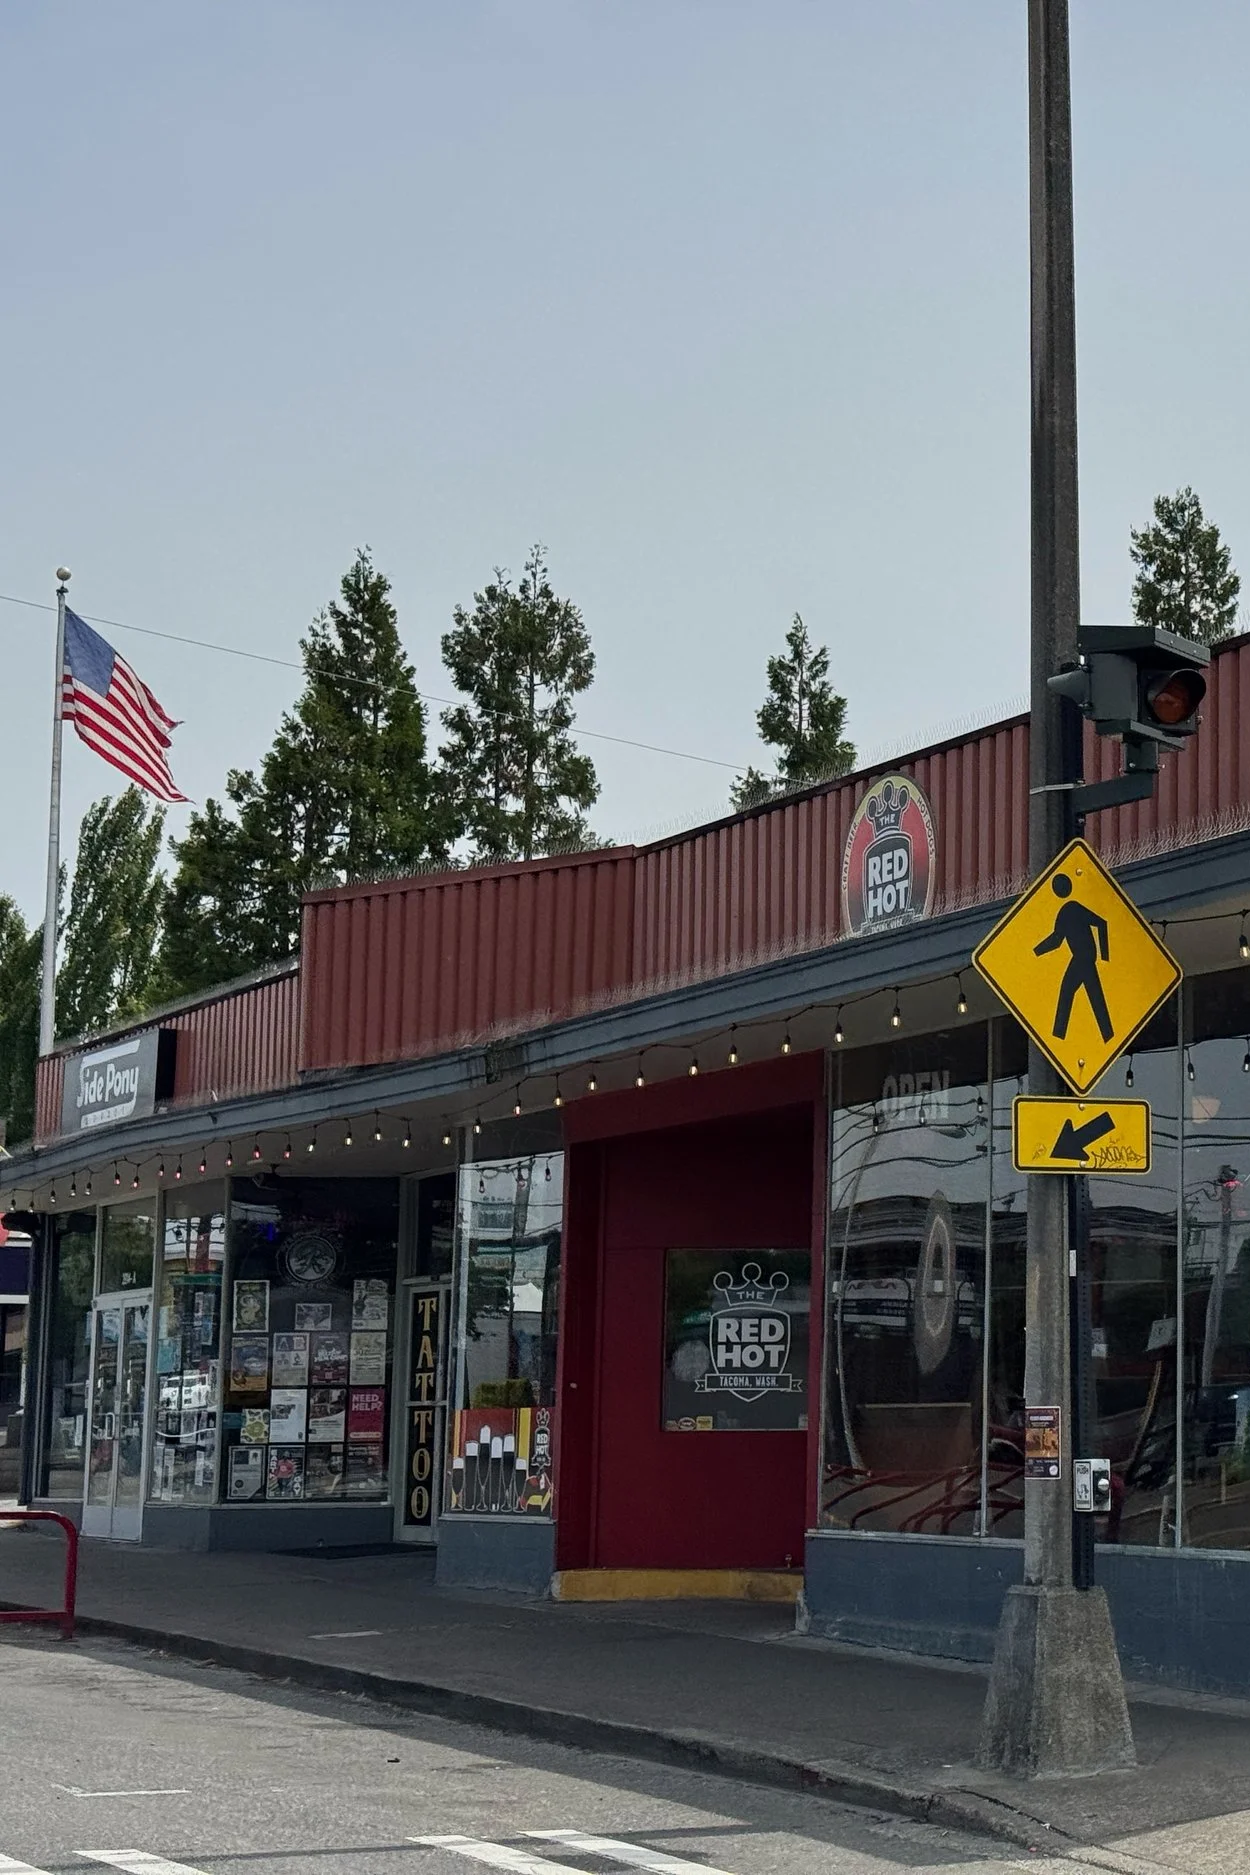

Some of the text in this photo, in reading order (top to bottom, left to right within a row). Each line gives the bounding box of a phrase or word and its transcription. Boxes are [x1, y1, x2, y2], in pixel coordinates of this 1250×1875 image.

[879, 813, 895, 826] THE
[868, 848, 909, 887] RED
[868, 879, 909, 918] HOT
[77, 1063, 139, 1108] Side Pony
[881, 1069, 950, 1121] OPEN
[736, 1291, 765, 1300] THE
[717, 1318, 785, 1343] RED
[717, 1344, 785, 1368] HOT
[351, 1402, 383, 1411] HELP?
[352, 1394, 380, 1403] NEED
[411, 1298, 437, 1519] TATTOO
[536, 1433, 548, 1444] RED
[536, 1445, 548, 1455] HOT
